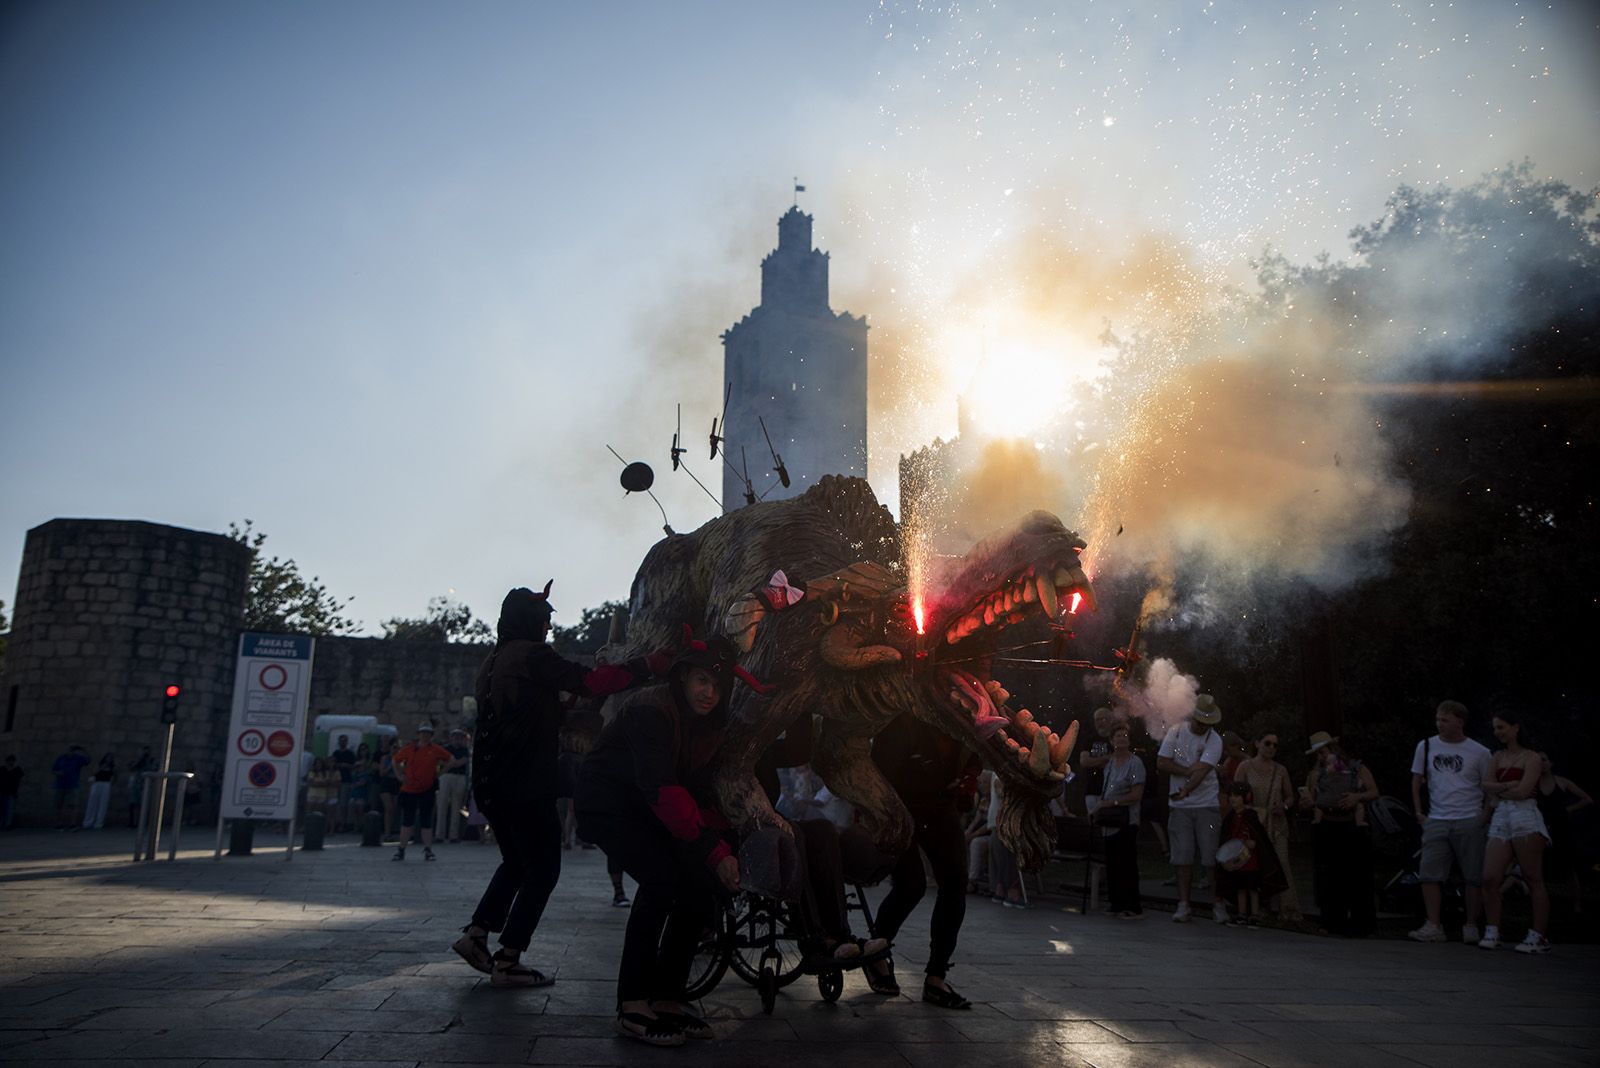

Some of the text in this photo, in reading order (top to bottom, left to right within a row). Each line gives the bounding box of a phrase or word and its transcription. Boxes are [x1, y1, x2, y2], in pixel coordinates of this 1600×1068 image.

[283, 640, 296, 648] DE
[253, 646, 298, 657] VIANANTS
[245, 737, 259, 750] 10
